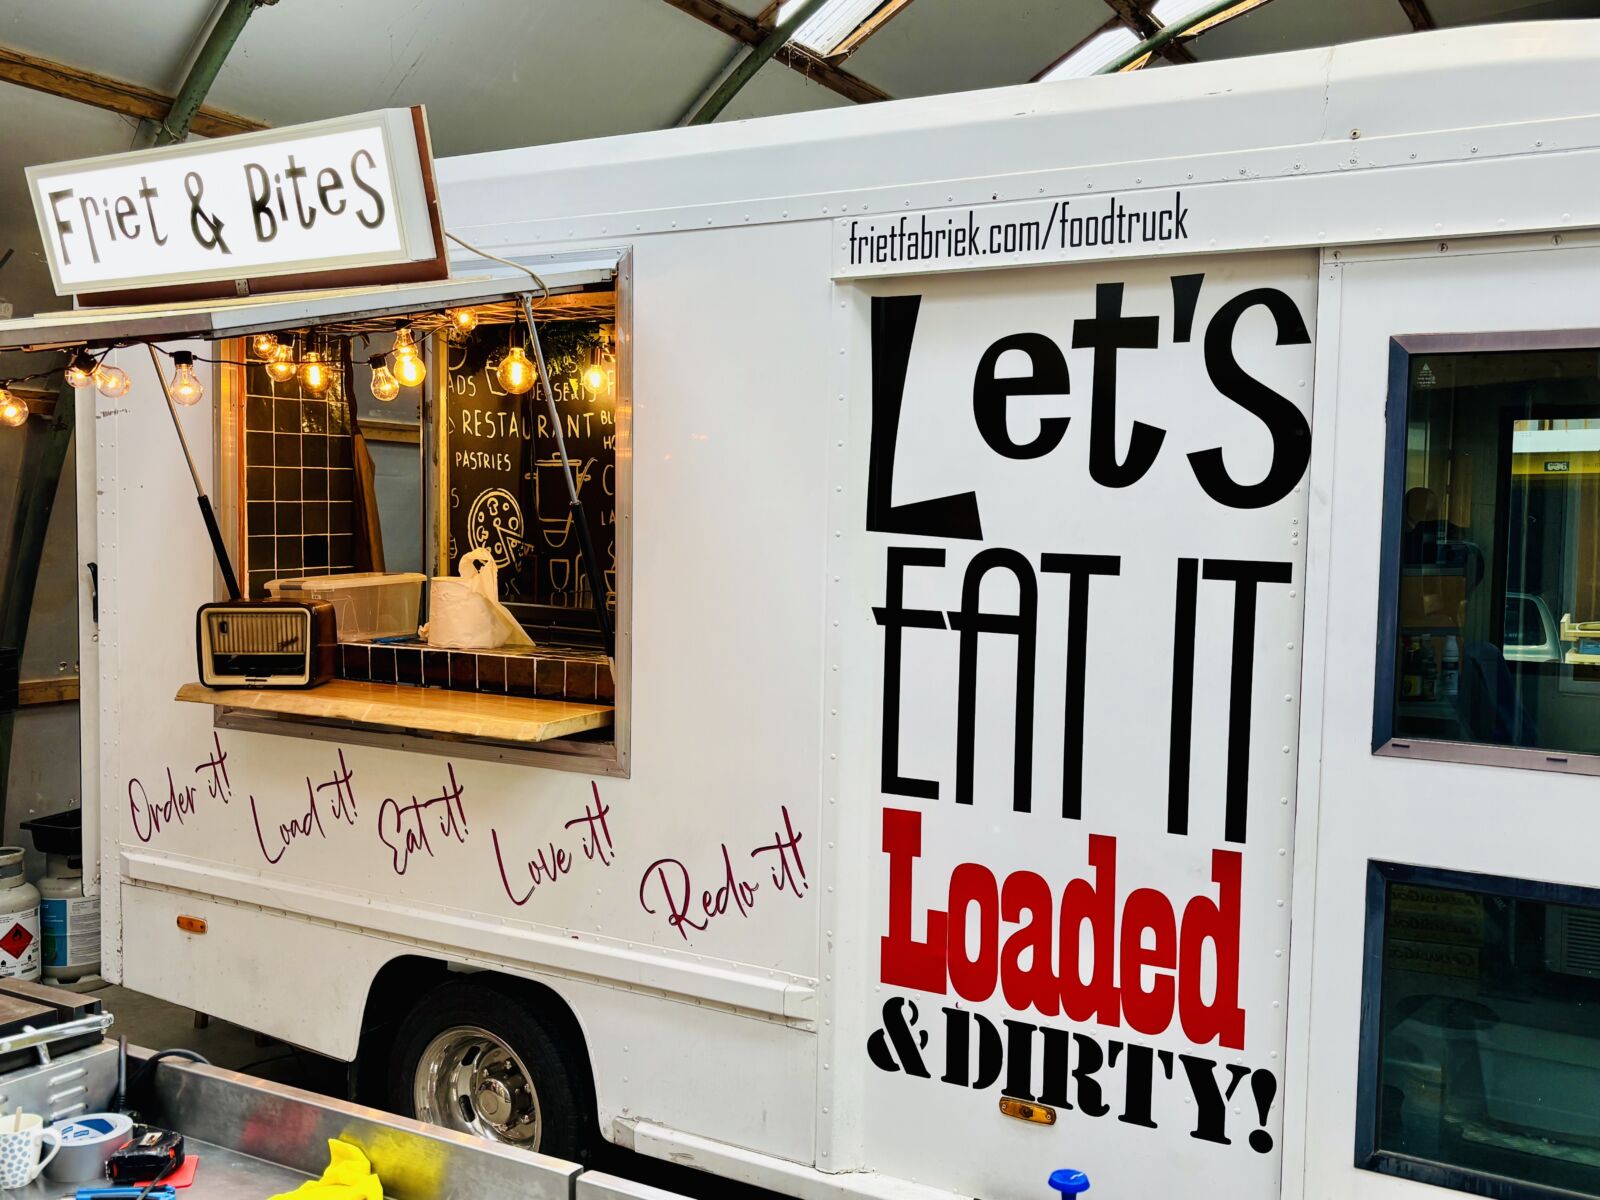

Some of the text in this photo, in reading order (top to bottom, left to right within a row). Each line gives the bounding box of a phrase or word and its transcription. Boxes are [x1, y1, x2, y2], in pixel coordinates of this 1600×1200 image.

[48, 176, 168, 265] Friet
[184, 171, 232, 255] &
[849, 191, 1189, 265] frietfabriek.com/foodtruck
[455, 450, 512, 472] PASTRIES
[462, 409, 595, 440] RESTAURNT
[871, 546, 1293, 844] EAT IT
[128, 731, 232, 842] Order it!
[249, 748, 358, 864] Load it!
[378, 762, 469, 875] Eat it!
[491, 780, 615, 906] Love it!
[639, 805, 808, 941] Redo it!
[880, 807, 1246, 1051] Loaded
[866, 996, 1277, 1154] & DIRTY!
